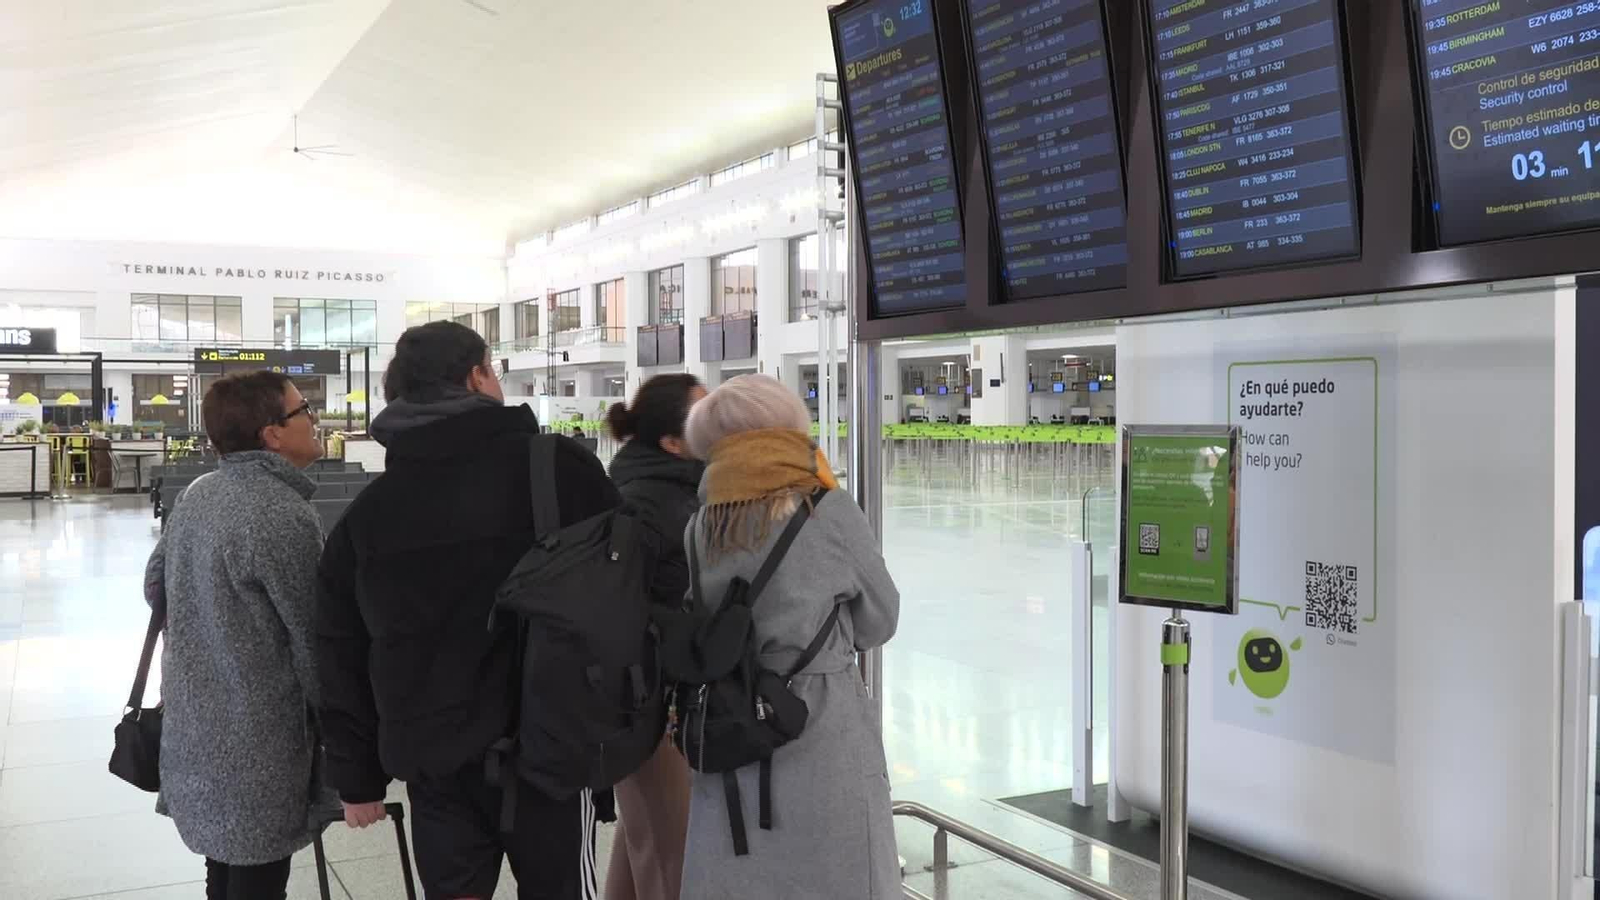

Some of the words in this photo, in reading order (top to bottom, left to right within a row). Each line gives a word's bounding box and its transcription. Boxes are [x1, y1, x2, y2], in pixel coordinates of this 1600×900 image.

[900, 1, 922, 20] 12:32
[1170, 0, 1206, 16] AMSTERDAM
[1172, 24, 1190, 36] LEEDS
[1222, 11, 1232, 20] FR
[1234, 4, 1249, 16] 2447
[1425, 17, 1446, 31] 19:35
[1446, 2, 1500, 24] ROTTERDAM
[1160, 49, 1174, 61] 17:15
[1174, 40, 1207, 56] FRANKFURT
[1225, 32, 1234, 40] LH
[1237, 26, 1251, 37] 1151
[1256, 16, 1281, 30] 359-360
[1427, 41, 1448, 55] 19:45
[1449, 27, 1504, 49] BIRMINGHAM
[1528, 15, 1548, 29] EZY
[1550, 8, 1573, 22] 6628
[856, 49, 902, 75] Departures
[1176, 64, 1198, 76] MADRID
[1227, 52, 1239, 61] IBE
[1258, 38, 1284, 52] 302-303
[1430, 67, 1451, 80] 19:45
[1452, 55, 1496, 74] CRACOVIA
[1531, 42, 1547, 54] W6
[1551, 35, 1574, 50] 2074
[1164, 90, 1178, 101] 17:40
[1178, 84, 1205, 96] ISTANBUL
[1230, 74, 1238, 83] TK
[1242, 68, 1256, 79] 1306
[1260, 60, 1285, 74] 317-321
[1478, 76, 1518, 95] Control
[1521, 70, 1535, 84] de
[1539, 56, 1600, 80] seguridad
[1232, 94, 1240, 104] AF
[1244, 90, 1258, 101] 1729
[1262, 82, 1288, 96] 350-351
[1480, 90, 1524, 110] Security
[1528, 80, 1567, 98] control
[1168, 130, 1182, 141] 17:55
[1182, 124, 1209, 137] TENERIFE
[1210, 122, 1215, 130] N
[1233, 116, 1247, 125] VLG
[1248, 110, 1263, 122] 3276
[1265, 104, 1290, 117] 307-308
[1482, 117, 1523, 133] Tiempo
[1526, 103, 1581, 123] estimado
[1584, 100, 1600, 111] de
[1184, 144, 1208, 157] LONDON
[1210, 142, 1221, 151] STN
[1236, 137, 1245, 146] FR
[1266, 126, 1292, 138] 363-372
[1483, 126, 1539, 147] Estimated
[1542, 116, 1585, 132] waiting
[1186, 166, 1200, 178] CLUJ
[1201, 162, 1226, 174] NAPOCA
[1238, 158, 1248, 166] W4
[1251, 154, 1266, 164] 3416
[1269, 148, 1294, 160] 233-234
[1512, 150, 1546, 180] 03
[1551, 166, 1568, 178] min
[1188, 186, 1209, 197] DUBLIN
[1240, 179, 1249, 188] FR
[1252, 176, 1267, 185] 7055
[1270, 170, 1296, 182] 363-372
[1190, 206, 1212, 217] MADRID
[1242, 200, 1249, 208] IB
[1252, 197, 1267, 206] 0044
[1273, 191, 1298, 203] 303-304
[1486, 204, 1524, 214] Mantenga
[1525, 197, 1557, 210] siempre
[1560, 194, 1570, 203] su
[1178, 230, 1192, 240] 19:00
[1192, 227, 1212, 237] BERLIN
[1244, 220, 1254, 228] FR
[1256, 218, 1268, 227] 233
[1275, 213, 1300, 225] 363-372
[1180, 250, 1194, 260] 19:00
[1194, 245, 1232, 257] CASABLANCA
[1246, 241, 1255, 249] AT
[1258, 239, 1269, 248] 985
[1278, 234, 1303, 245] 334-335
[124, 264, 207, 277] TERMINAL
[216, 268, 266, 279] PABLO
[274, 270, 310, 280] RUIZ
[318, 272, 384, 282] PICASSO
[1240, 380, 1261, 398] ¿En
[1265, 379, 1288, 398] qué
[1293, 378, 1334, 398] puedo
[1240, 401, 1304, 419] ayudarte?
[1269, 433, 1289, 446] can
[1246, 452, 1270, 468] help
[1274, 453, 1302, 470] you?
